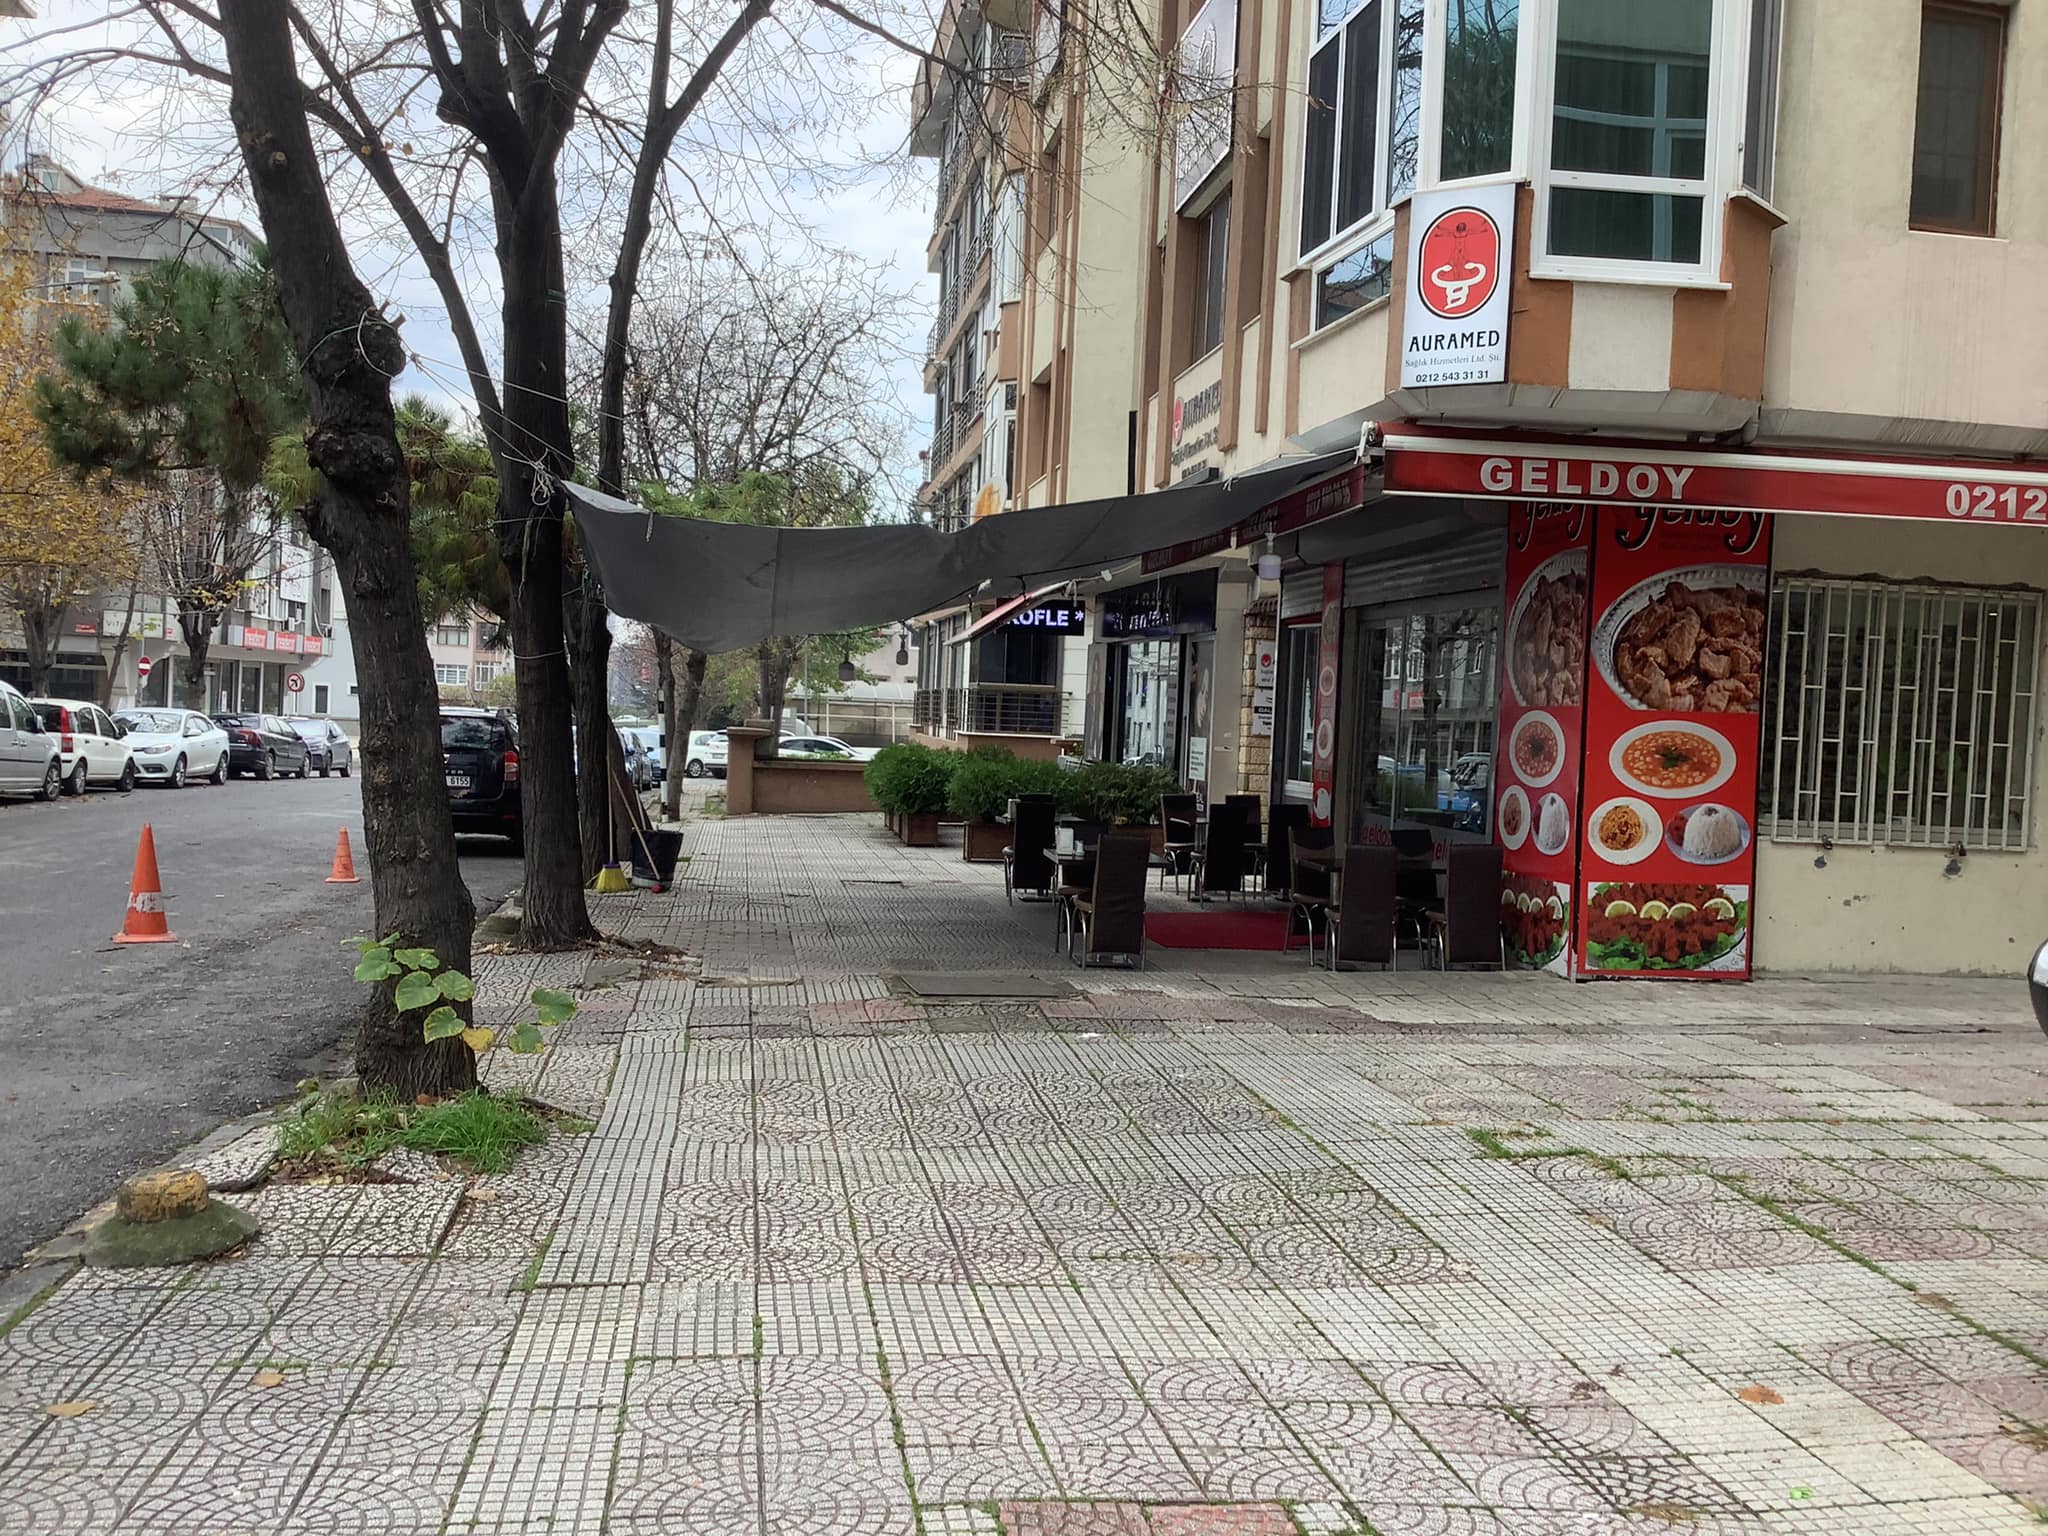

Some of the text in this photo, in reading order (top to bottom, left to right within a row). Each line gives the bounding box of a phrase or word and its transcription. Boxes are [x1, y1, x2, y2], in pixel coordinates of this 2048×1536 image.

[1408, 330, 1501, 353] AURAMED
[1415, 370, 1489, 383] 0212 543 31 31
[1480, 457, 2048, 521] GELDOY 0212
